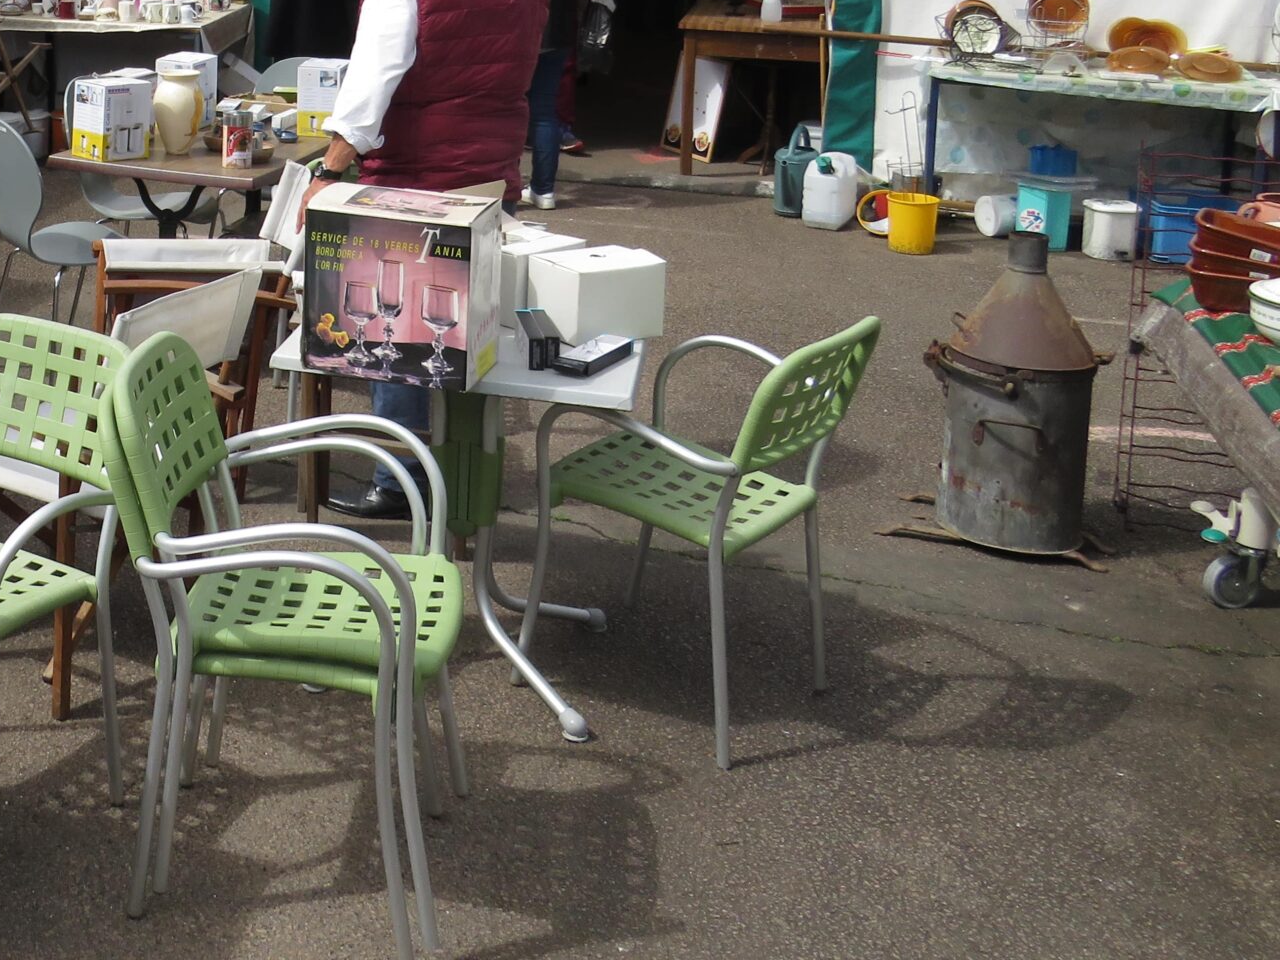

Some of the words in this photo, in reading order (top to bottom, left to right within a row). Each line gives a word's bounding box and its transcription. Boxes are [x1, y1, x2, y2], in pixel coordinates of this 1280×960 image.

[310, 231, 348, 245] SERVICE
[352, 236, 364, 246] DE
[384, 241, 420, 254] VERRES
[315, 246, 335, 257] BORD
[332, 261, 345, 272] FIN
